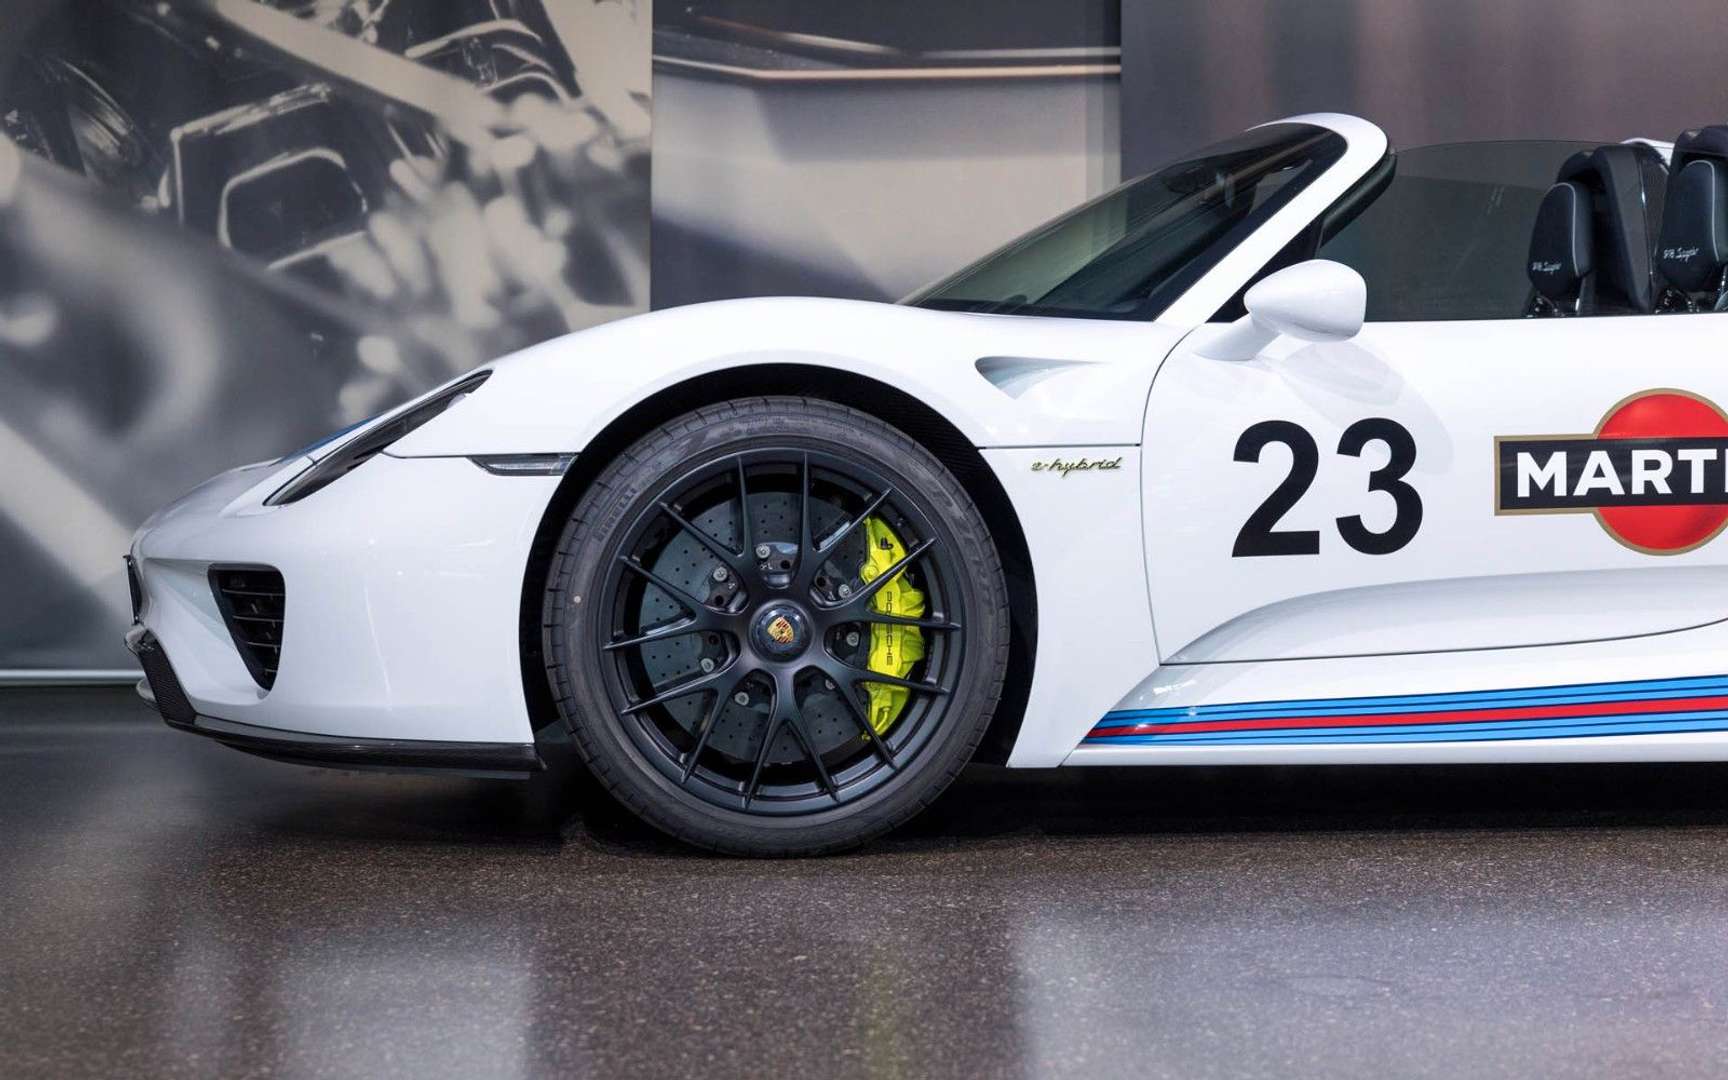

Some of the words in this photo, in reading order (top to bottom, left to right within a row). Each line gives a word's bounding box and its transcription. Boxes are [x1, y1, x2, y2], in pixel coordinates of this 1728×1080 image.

[1031, 457, 1122, 477] e-hybrid
[1231, 417, 1423, 557] 23
[1517, 448, 1728, 497] MART
